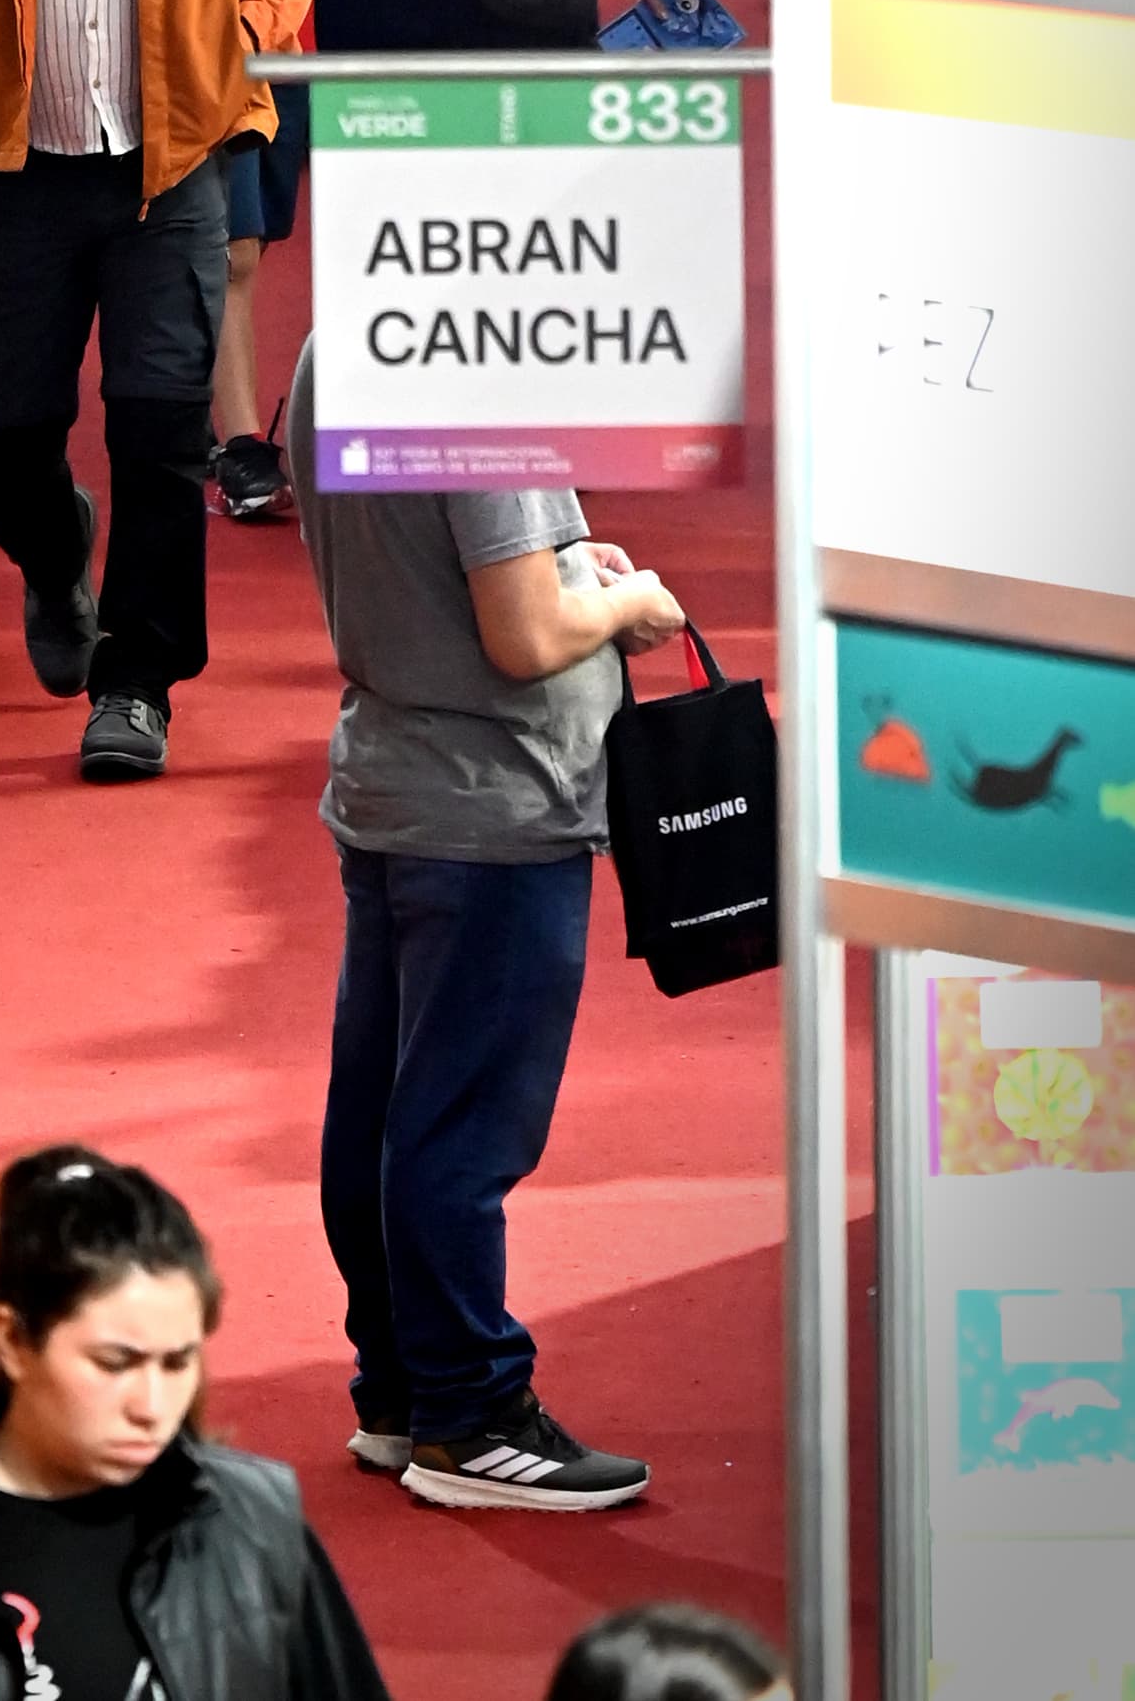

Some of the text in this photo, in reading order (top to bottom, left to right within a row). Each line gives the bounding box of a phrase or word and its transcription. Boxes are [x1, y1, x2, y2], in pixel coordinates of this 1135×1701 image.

[338, 113, 427, 138] VERDE
[587, 82, 729, 144] 833
[367, 218, 618, 275] ABRAN
[368, 307, 687, 366] CANCHA
[658, 796, 748, 834] SAMSUNG
